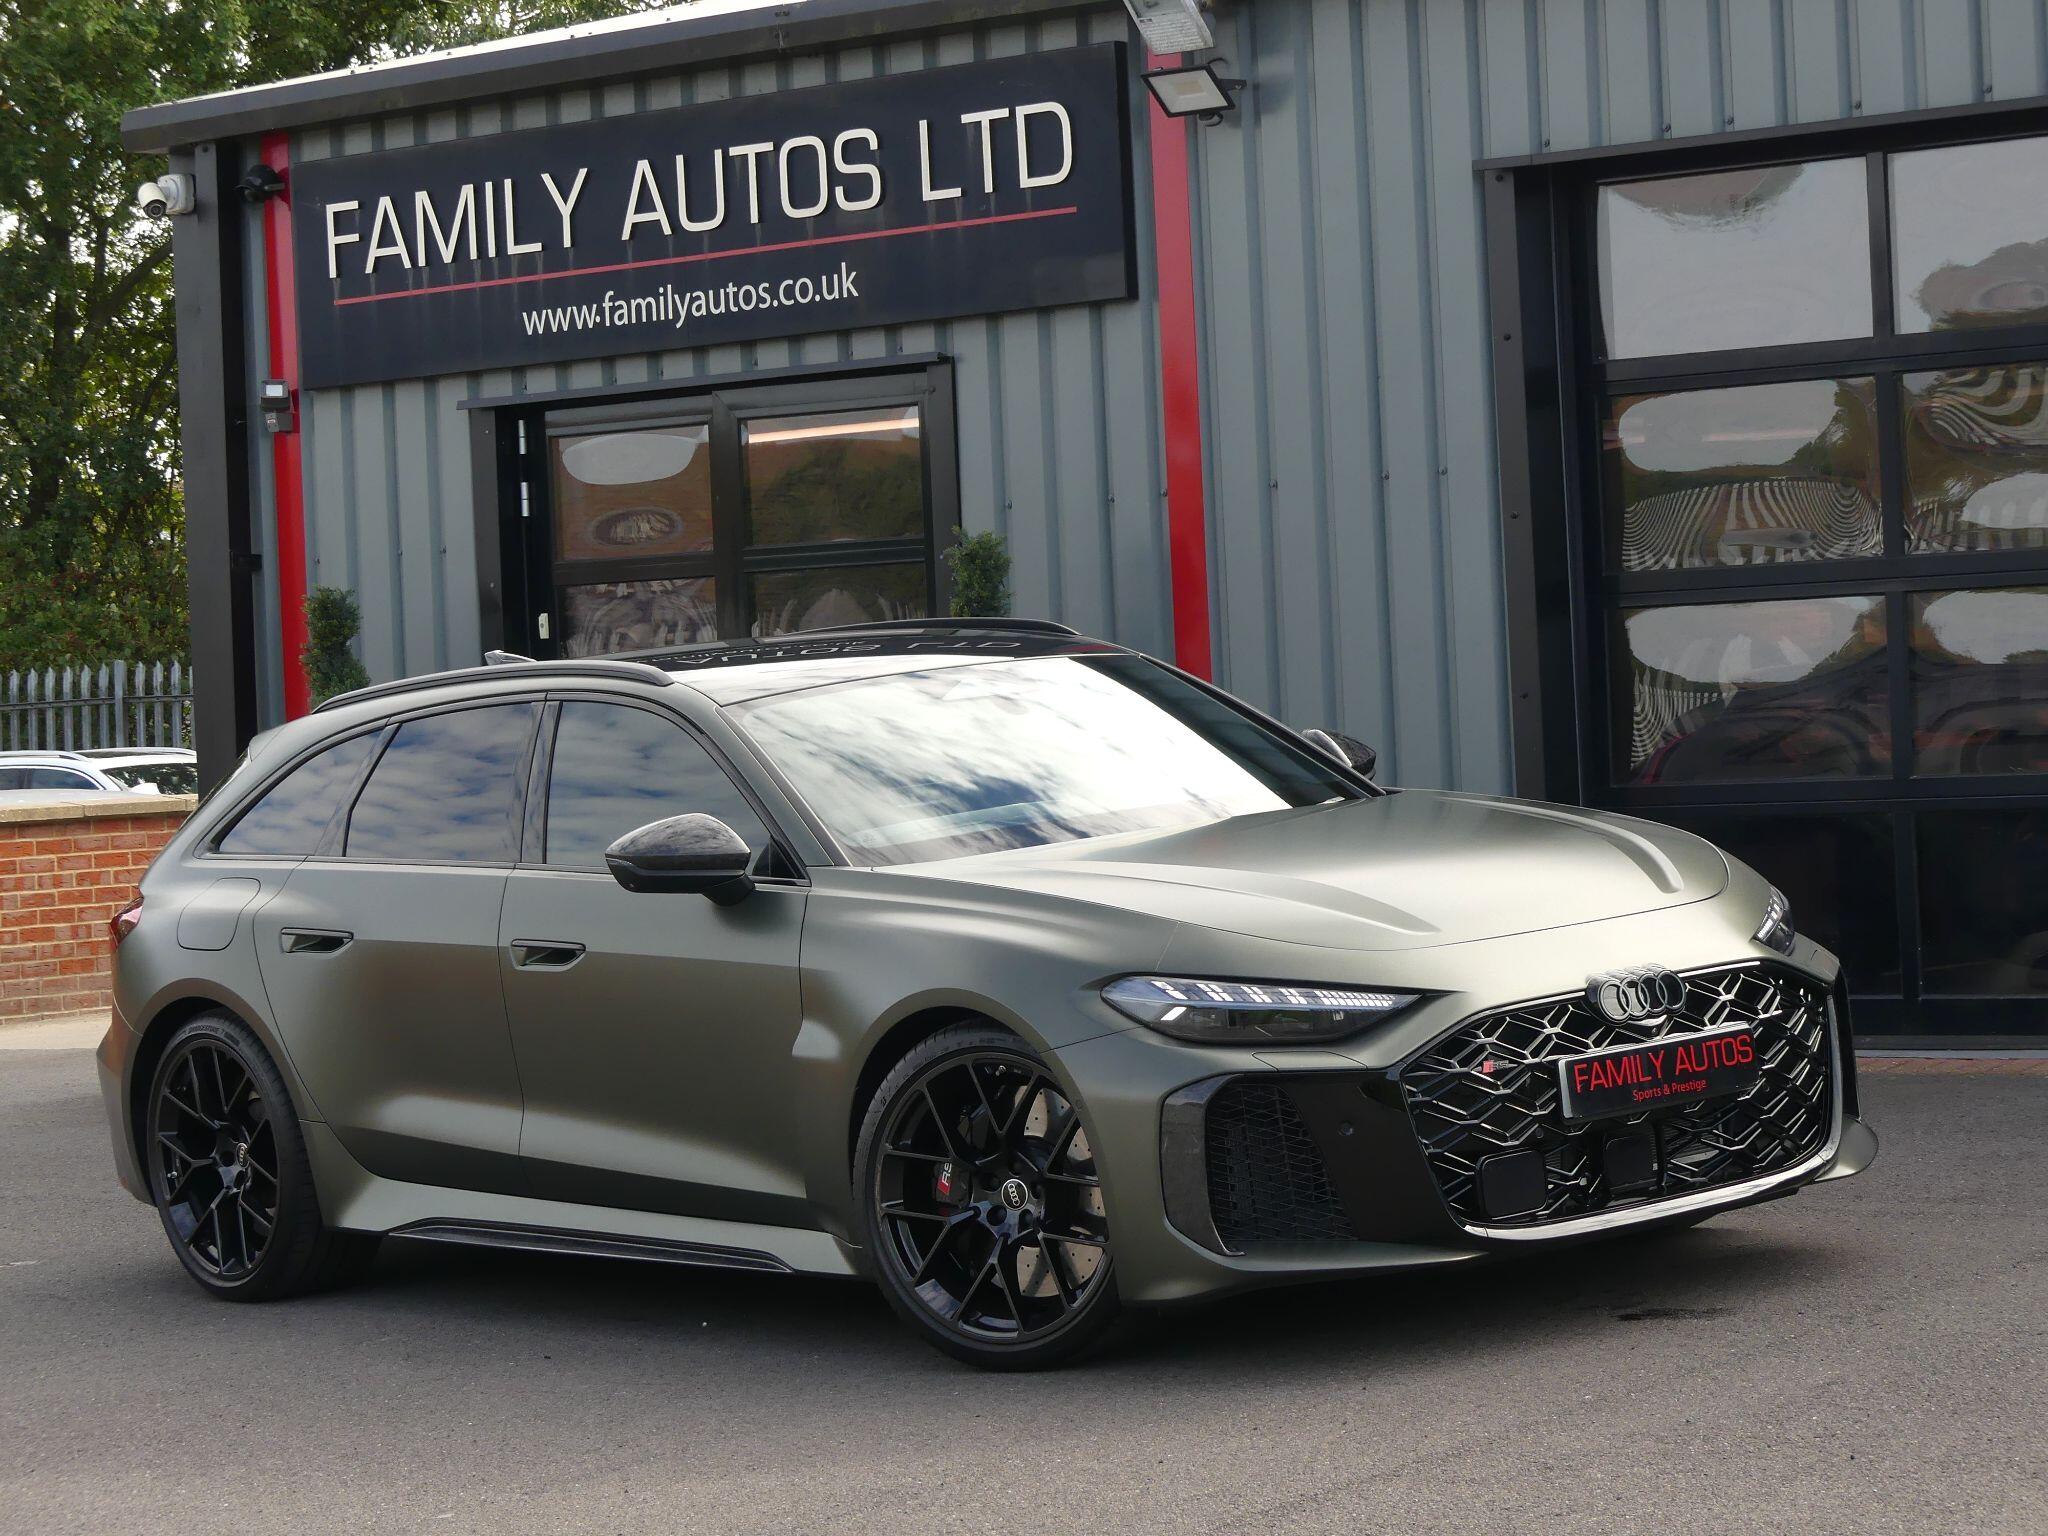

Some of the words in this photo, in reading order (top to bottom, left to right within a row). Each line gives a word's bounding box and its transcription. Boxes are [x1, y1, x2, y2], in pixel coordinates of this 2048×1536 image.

[325, 168, 589, 280] FAMILY
[621, 127, 882, 242] AUTOS
[919, 101, 1073, 202] LTD
[522, 262, 860, 336] www.familyautos.co.uk
[1574, 1050, 1665, 1093] FAMILY
[1675, 1034, 1754, 1076] AUTOS
[1632, 1087, 1662, 1102] Sports
[1664, 1083, 1670, 1095] &
[1672, 1078, 1707, 1094] Prestige
